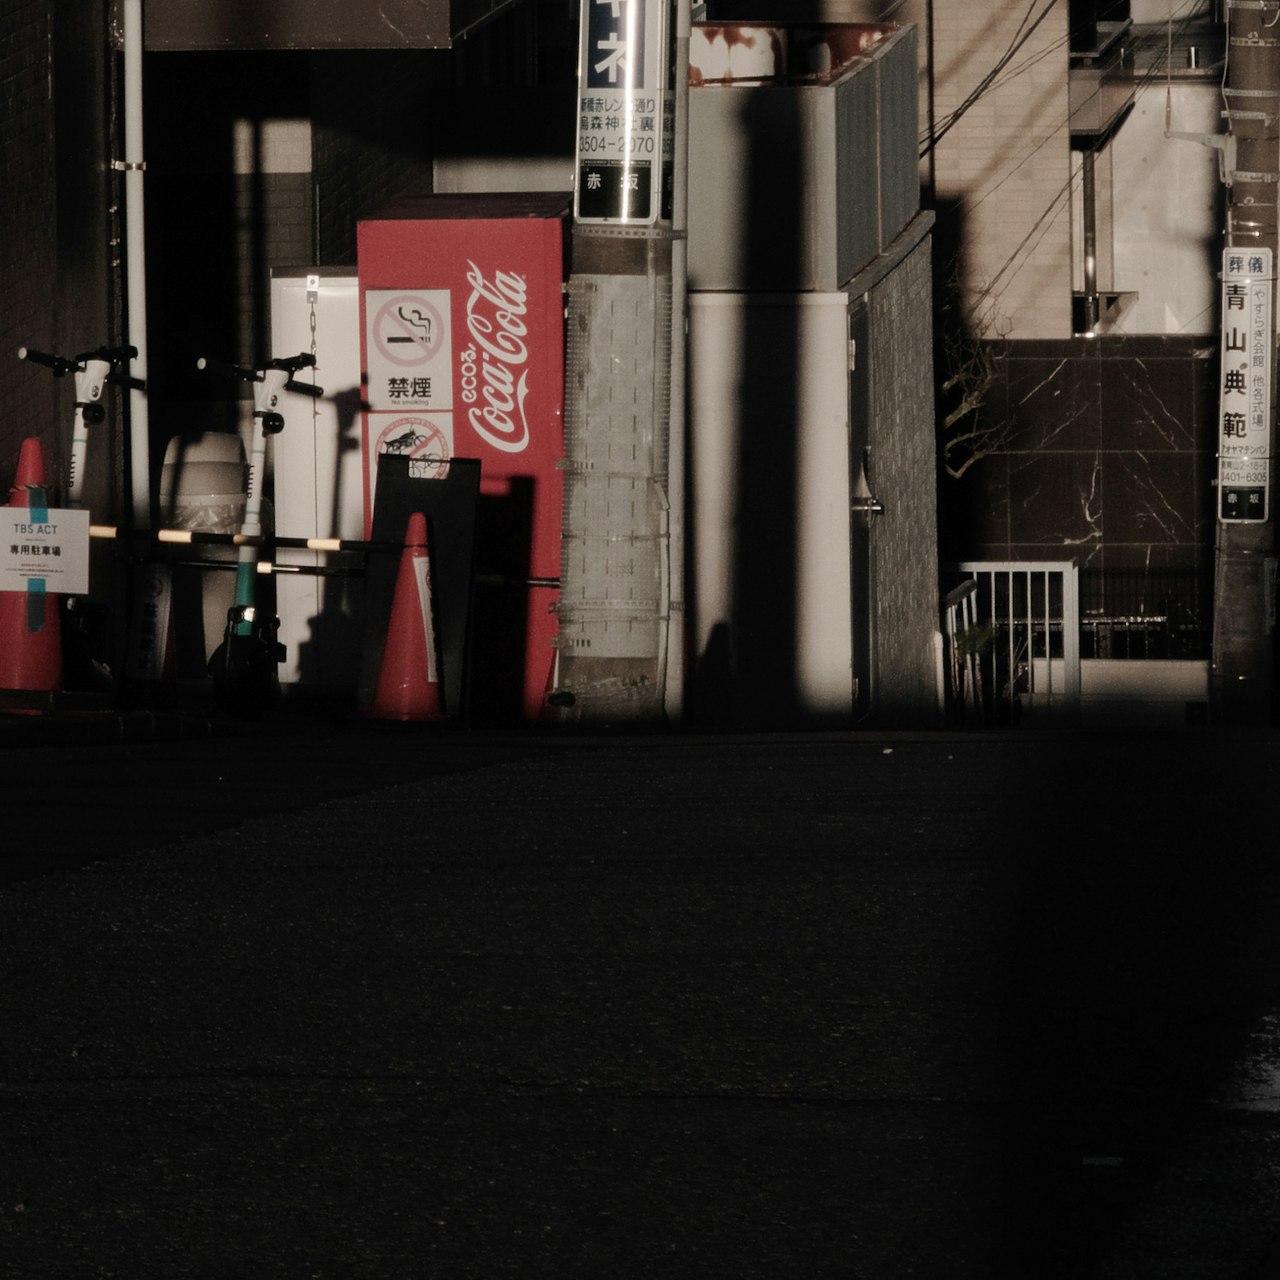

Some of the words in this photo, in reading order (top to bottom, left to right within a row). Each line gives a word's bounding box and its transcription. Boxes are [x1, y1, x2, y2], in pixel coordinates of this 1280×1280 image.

[587, 173, 639, 190] 赤坂
[467, 259, 529, 453] Coca-Cola
[1223, 284, 1249, 439] 青山典範
[388, 377, 432, 399] 禁煙
[391, 398, 403, 406] No
[14, 524, 34, 534] TBS
[36, 525, 58, 535] ACT
[10, 545, 62, 557] 専用駐車場
